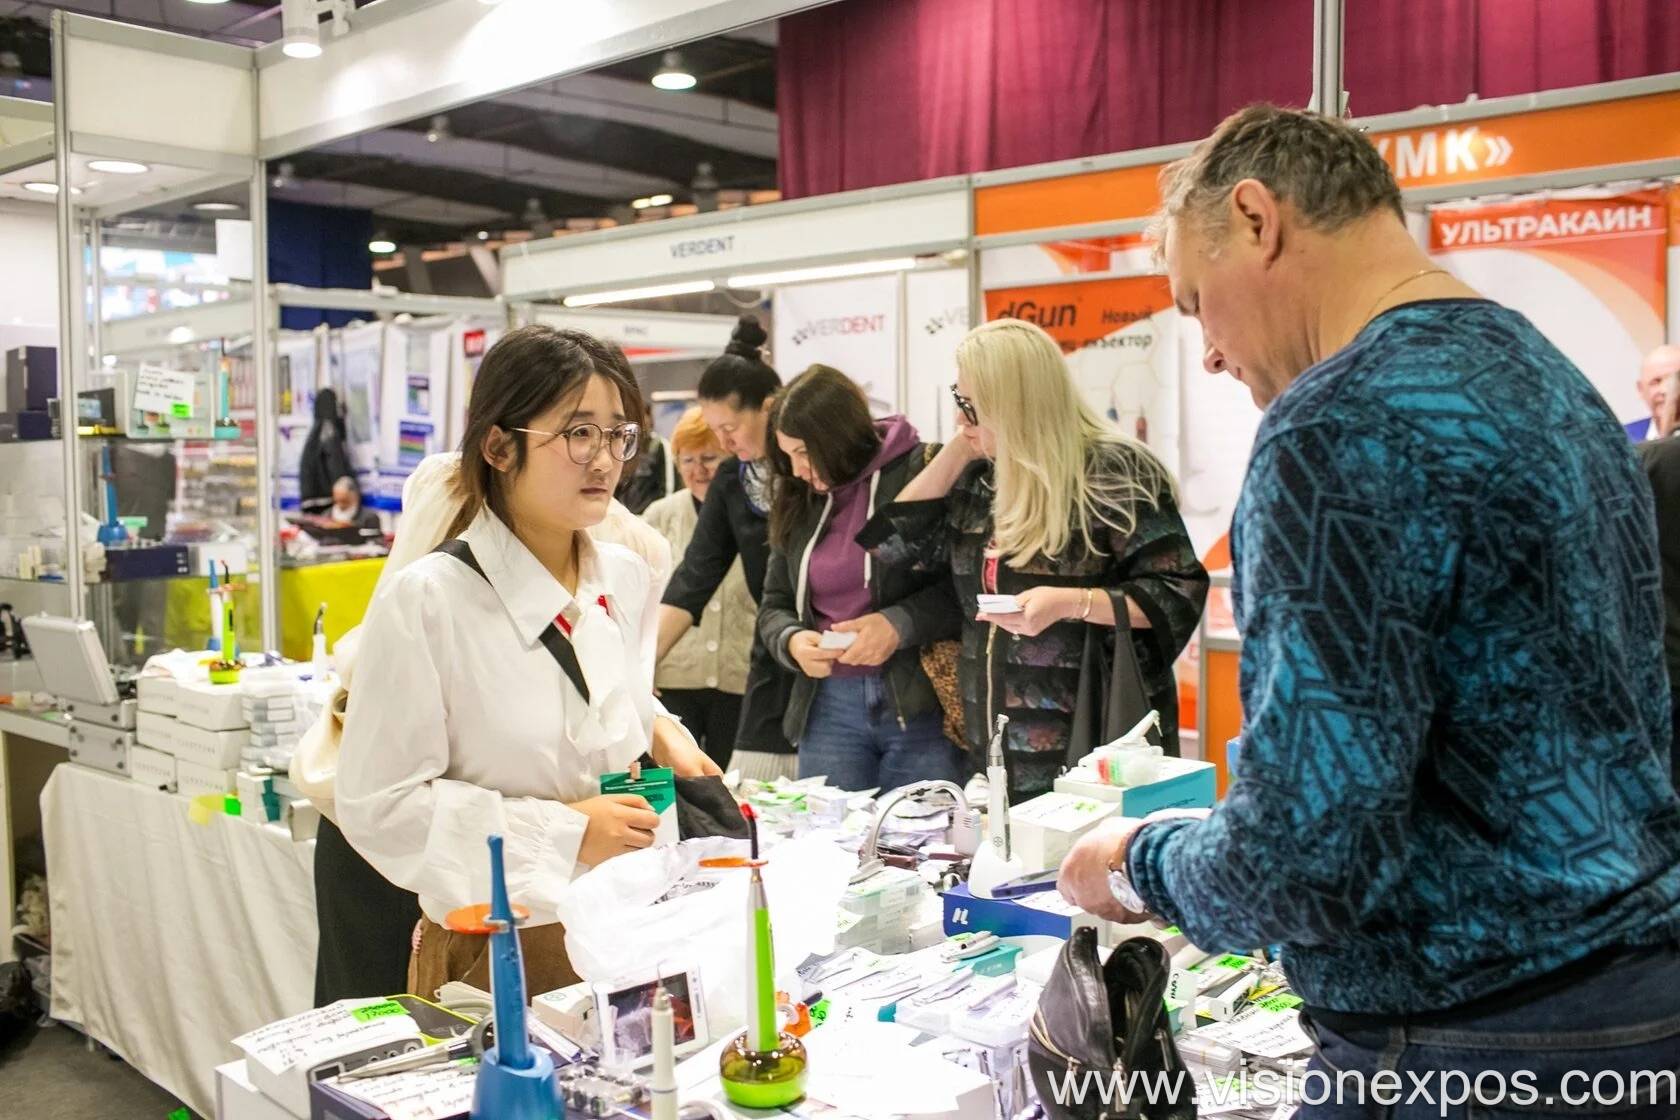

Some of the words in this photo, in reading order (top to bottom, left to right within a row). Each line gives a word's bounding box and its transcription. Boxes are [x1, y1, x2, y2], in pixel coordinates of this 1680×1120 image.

[1440, 206, 1652, 246] УЛЬТРАКАИН
[671, 235, 736, 259] VERDENT
[806, 313, 885, 337] VERDENT
